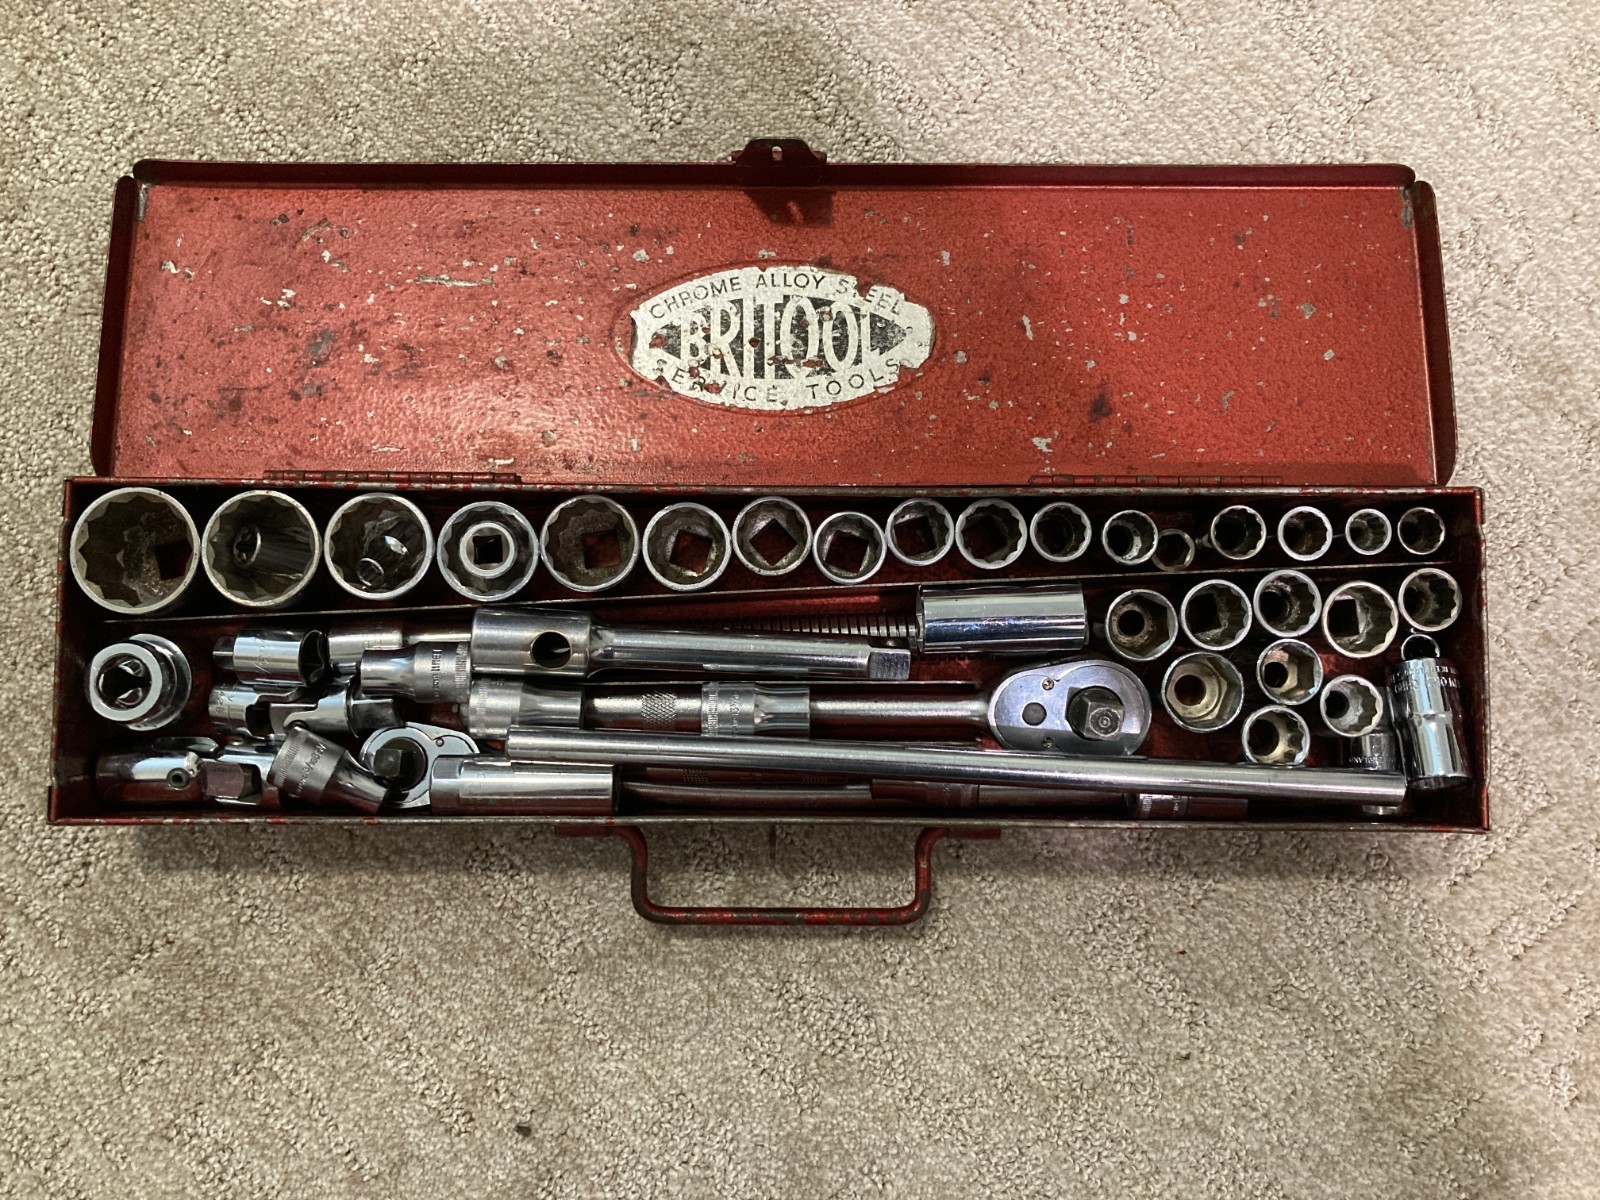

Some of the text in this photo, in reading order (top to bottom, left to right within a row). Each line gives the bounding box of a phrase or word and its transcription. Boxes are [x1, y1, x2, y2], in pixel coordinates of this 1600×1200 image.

[650, 277, 742, 319] CHROME
[756, 273, 826, 289] ALLOY
[679, 295, 881, 380] BRITOOL
[806, 358, 900, 399] TOOLS
